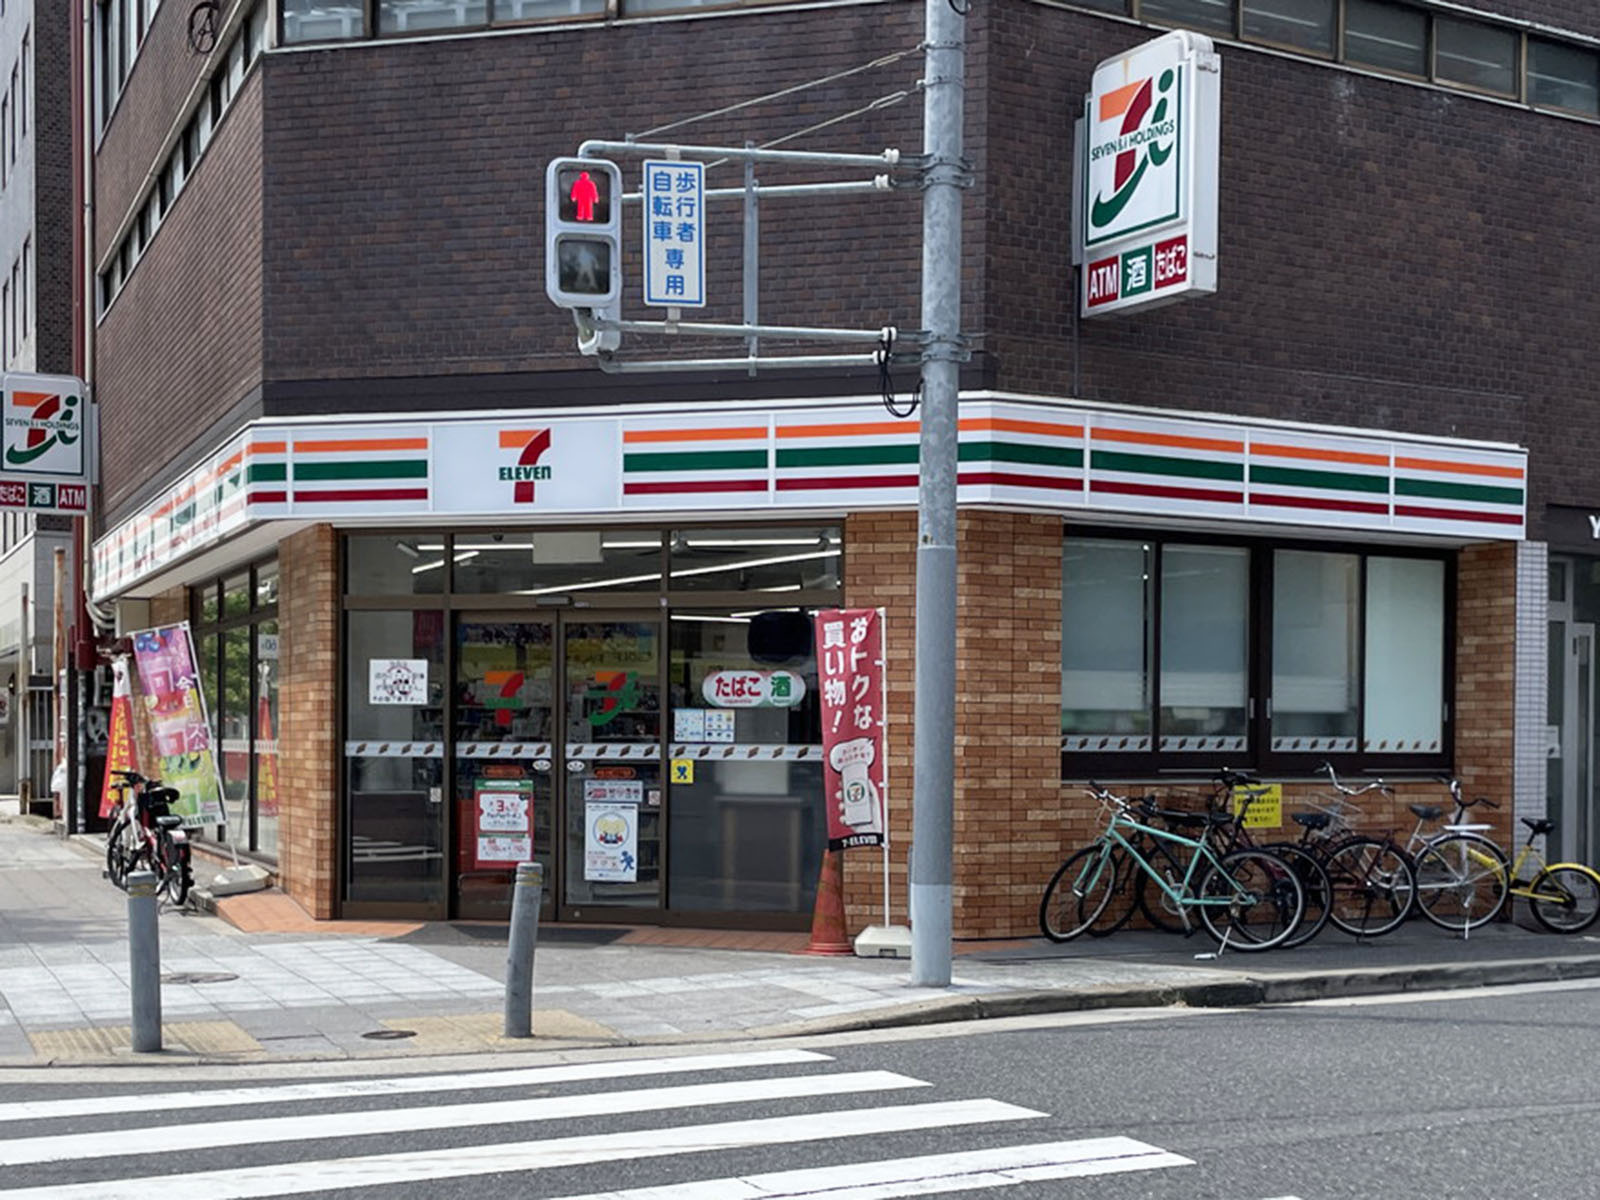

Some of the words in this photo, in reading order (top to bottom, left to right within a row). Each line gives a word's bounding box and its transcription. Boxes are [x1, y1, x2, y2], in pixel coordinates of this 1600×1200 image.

[652, 171, 674, 242] 自転車
[675, 172, 696, 243] 歩行者
[664, 248, 685, 296] 専用
[1126, 254, 1148, 292] 酒
[1156, 244, 1187, 281] たばこ
[1089, 263, 1118, 300] ATM
[32, 486, 52, 506] 酒
[59, 488, 85, 506] ATM
[715, 676, 761, 697] たばこ
[771, 676, 791, 697] 酒
